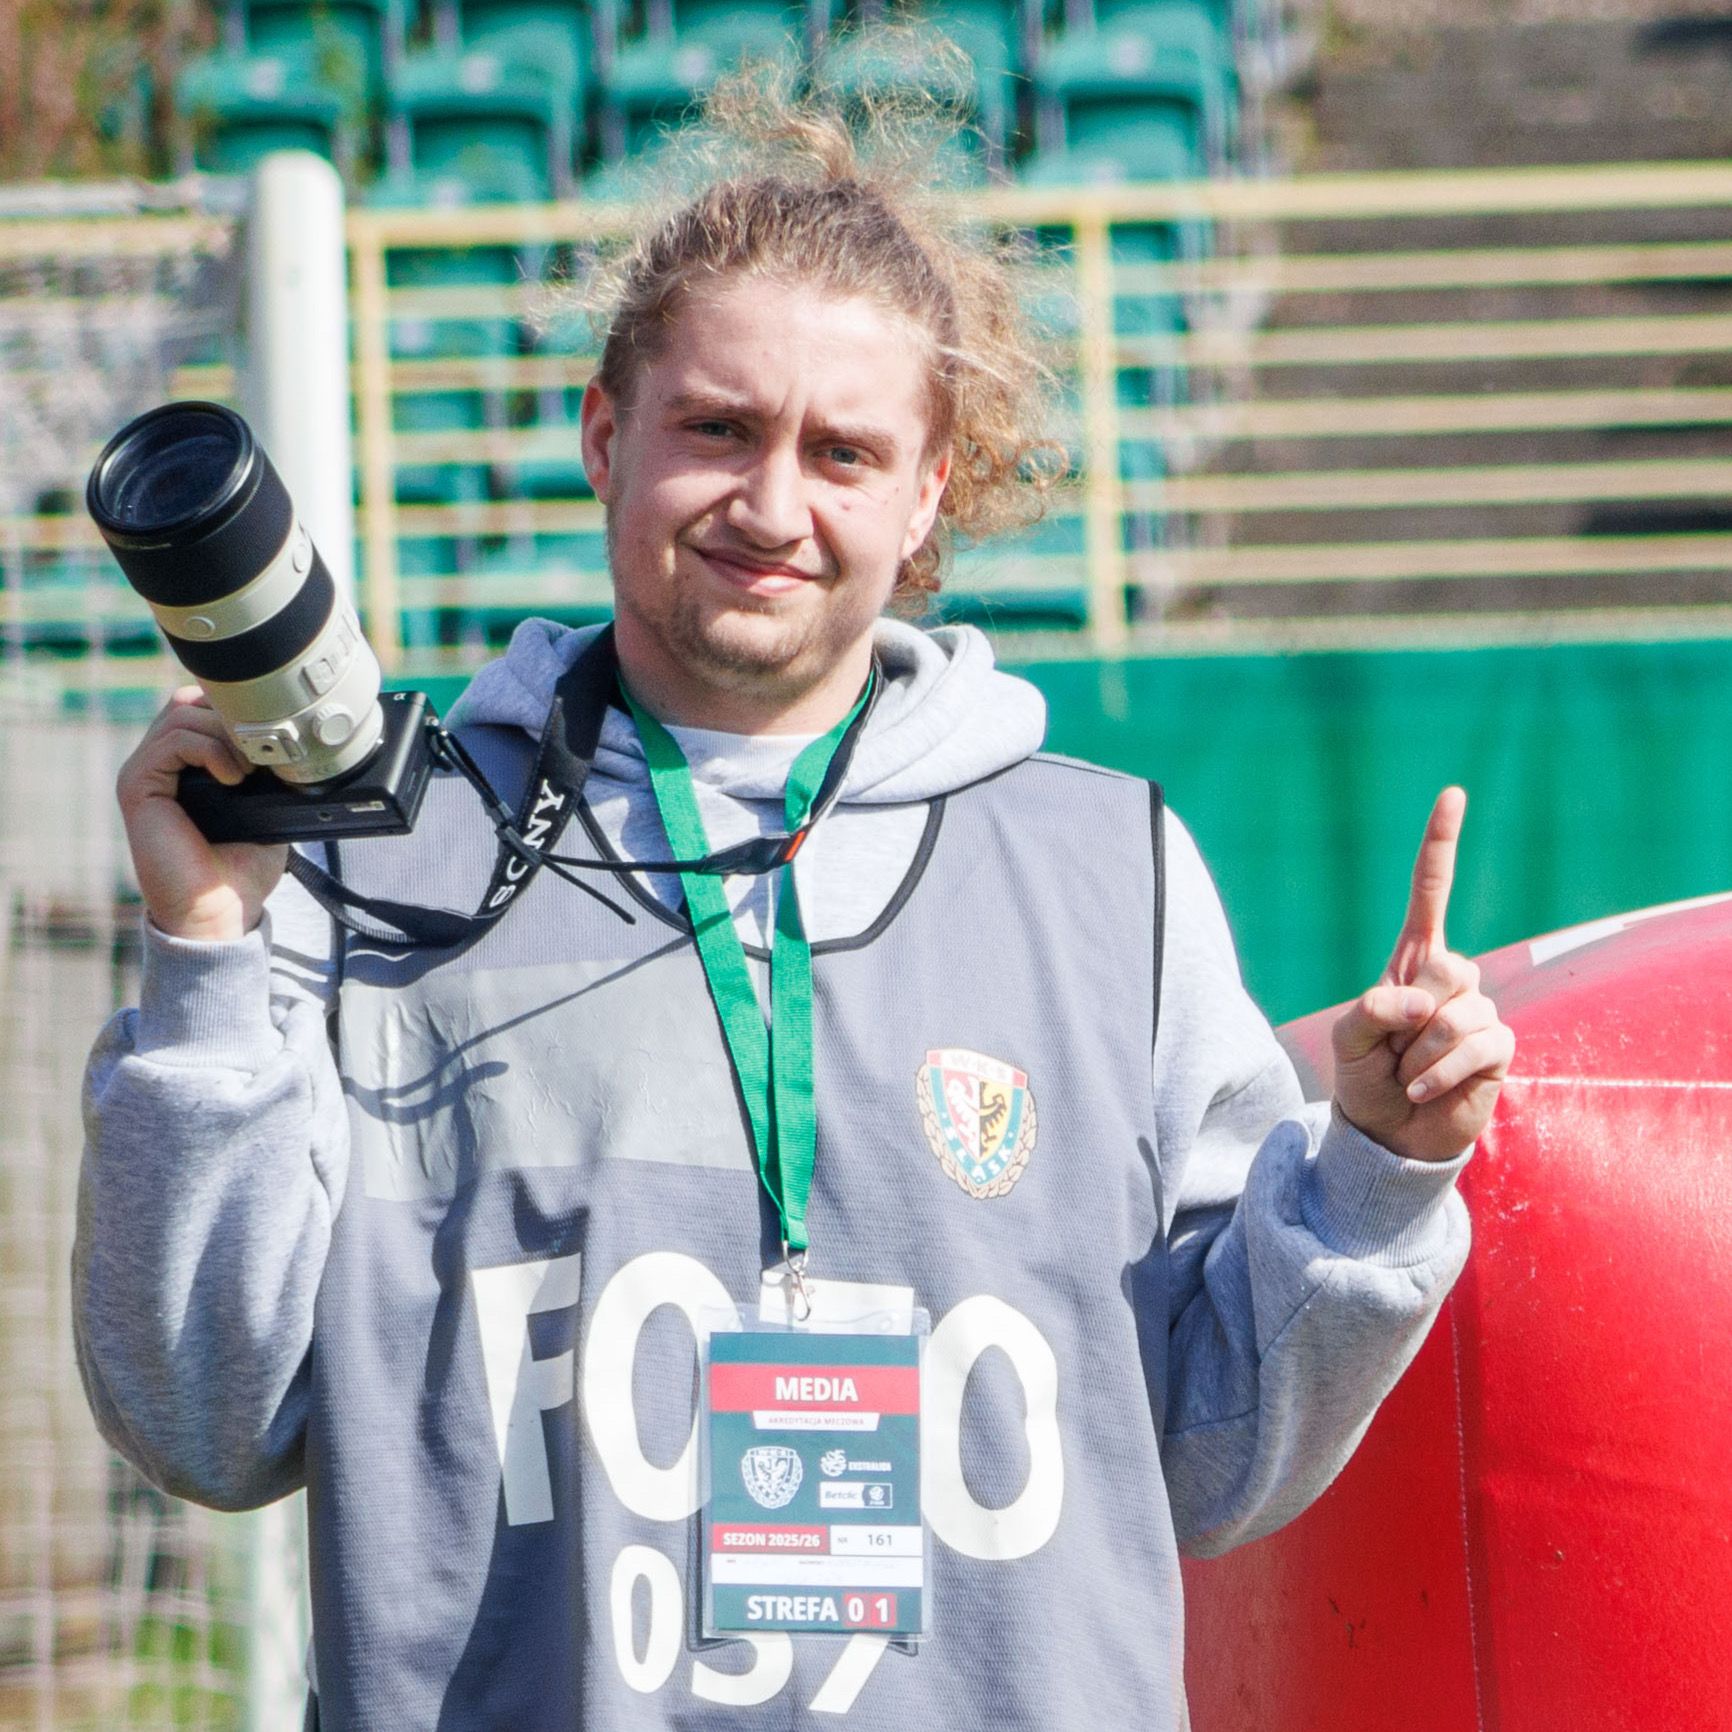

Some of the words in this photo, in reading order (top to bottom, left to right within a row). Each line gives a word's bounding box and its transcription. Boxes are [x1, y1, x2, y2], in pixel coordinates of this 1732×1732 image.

[775, 1376, 859, 1402] MEDIA
[723, 1532, 766, 1546] SEZON
[768, 1534, 820, 1547] 2025/26
[868, 1534, 893, 1546] 161
[747, 1594, 839, 1622] STREFA
